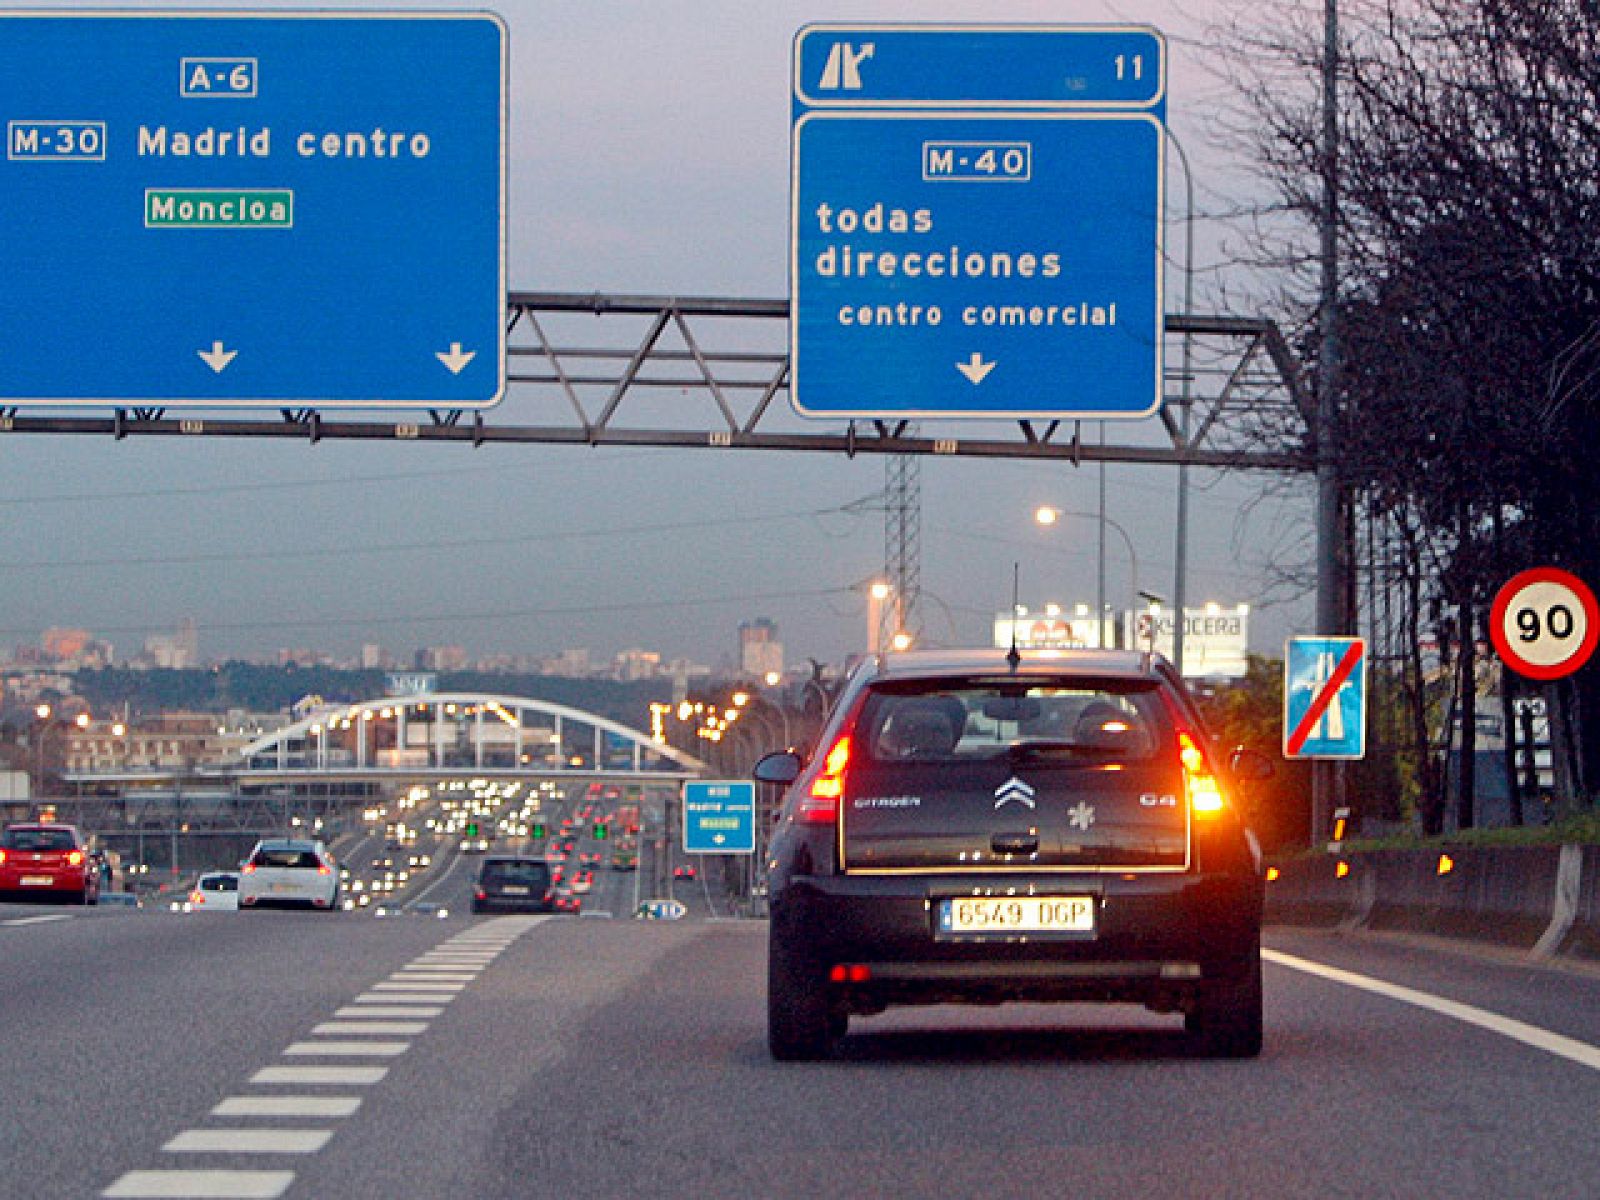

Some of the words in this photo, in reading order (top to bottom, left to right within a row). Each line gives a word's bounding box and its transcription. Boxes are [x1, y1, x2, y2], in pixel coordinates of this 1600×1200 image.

[189, 64, 250, 90] A-6
[1114, 54, 1142, 80] 11
[13, 128, 99, 154] M-30
[137, 126, 271, 157] Madrid
[297, 128, 430, 157] centro
[929, 149, 1024, 174] M-40
[151, 196, 287, 222] Moncloa
[816, 203, 932, 233] todas
[816, 245, 1061, 277] direcciones
[839, 303, 942, 326] centro
[962, 302, 1116, 326] comercial
[1516, 604, 1573, 643] 90
[959, 901, 1024, 926] 6549
[1038, 901, 1087, 926] DGP
